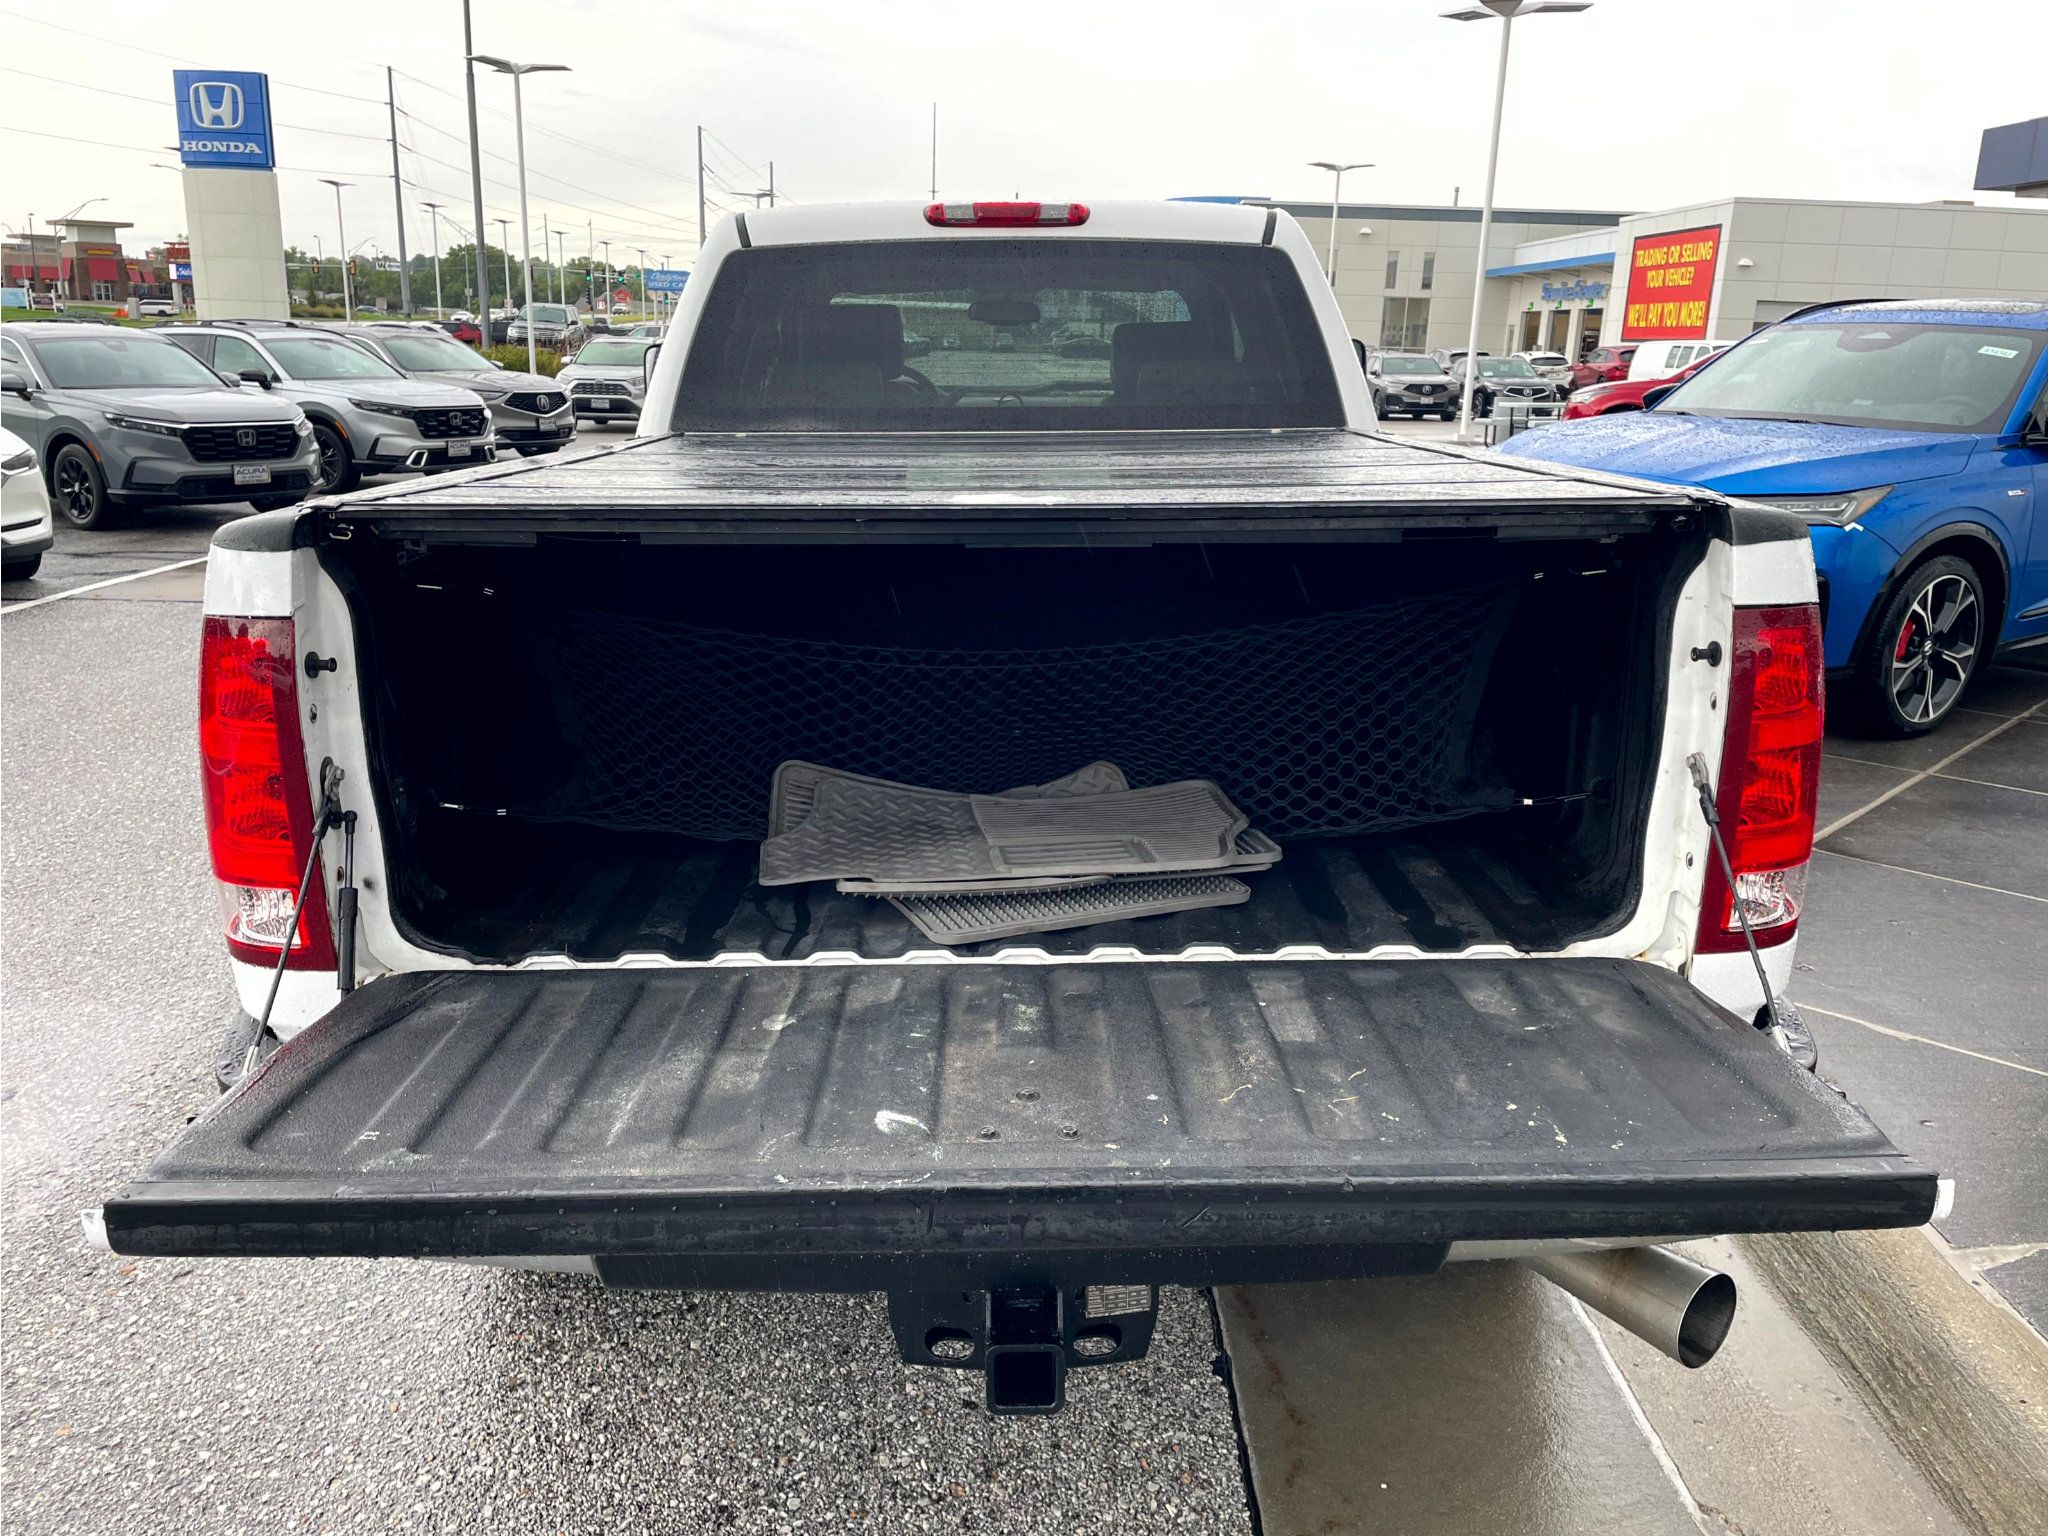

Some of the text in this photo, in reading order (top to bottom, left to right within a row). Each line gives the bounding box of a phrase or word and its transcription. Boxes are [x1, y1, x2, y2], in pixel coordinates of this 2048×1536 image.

[182, 140, 263, 154] HONDA
[1636, 241, 1713, 268] TRADING OR SELLING
[1646, 267, 1695, 288] YOUR VEHICLE?
[1542, 280, 1610, 301] Service Center
[1627, 301, 1706, 328] WE'LL PAY YOU MORE!
[236, 467, 267, 475] ACURA
